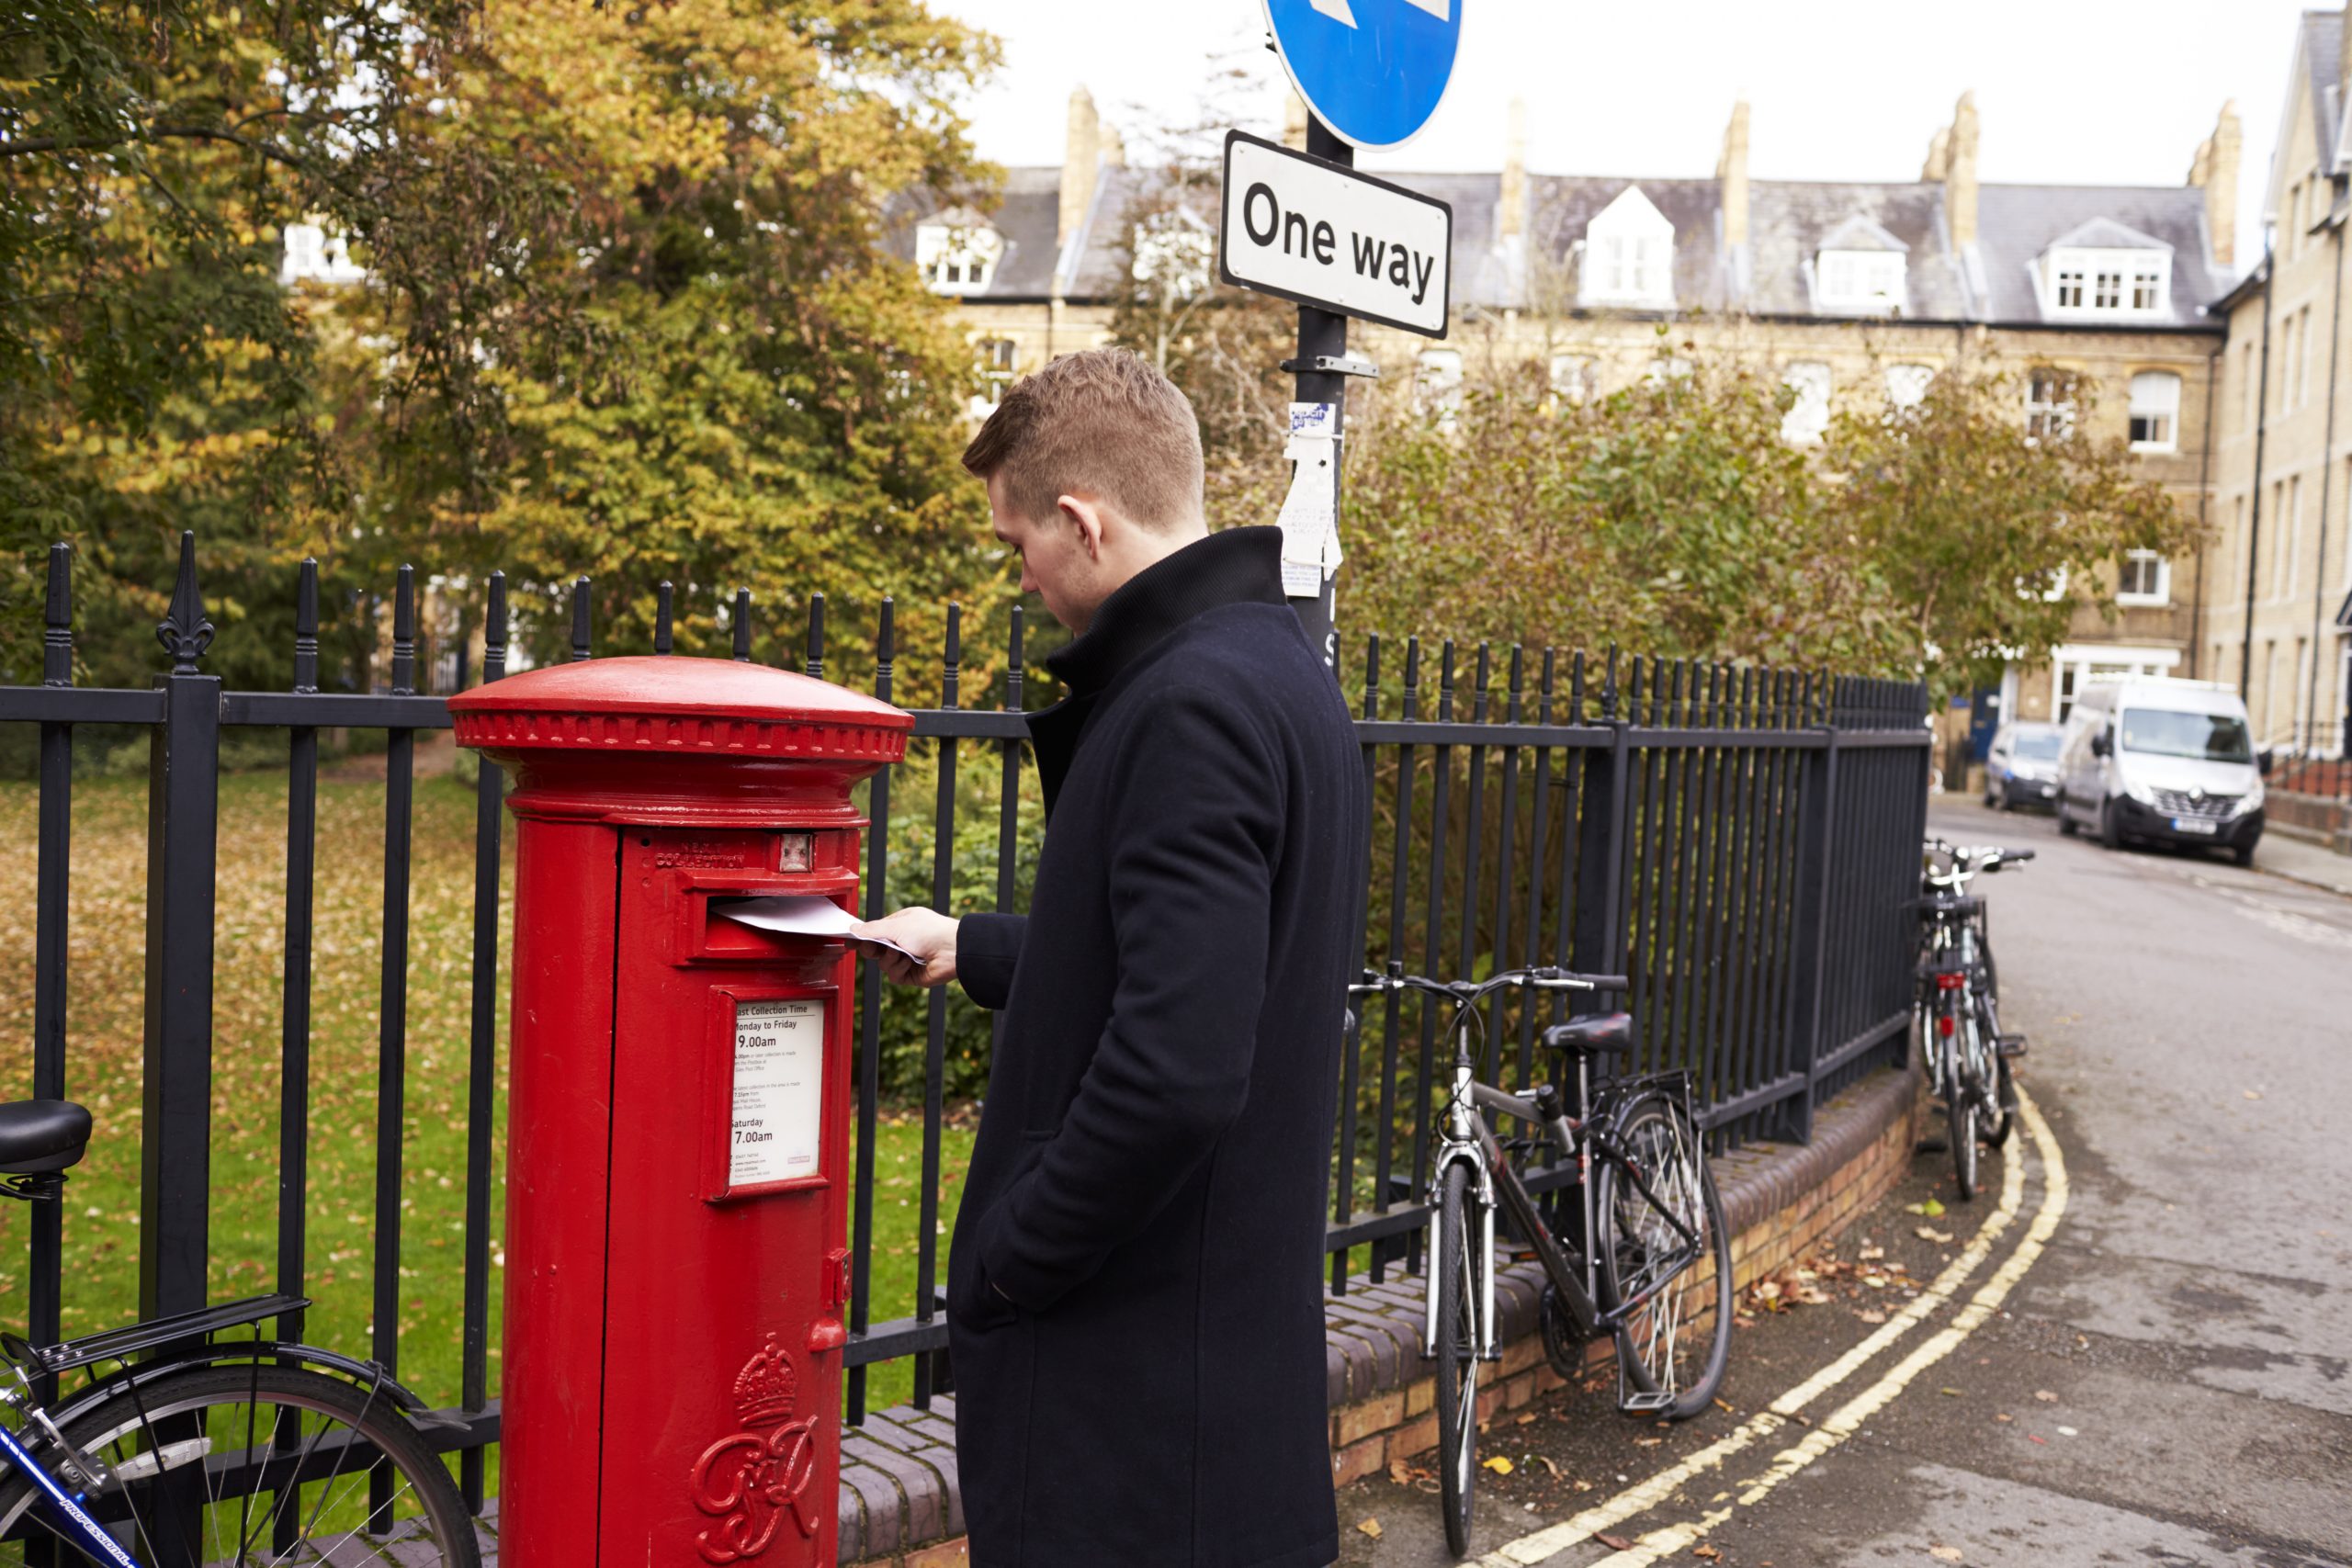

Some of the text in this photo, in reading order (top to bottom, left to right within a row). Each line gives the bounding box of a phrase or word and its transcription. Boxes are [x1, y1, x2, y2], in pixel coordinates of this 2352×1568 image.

[1243, 182, 1434, 305] One way
[653, 852, 745, 869] COLLECTION
[736, 1005, 808, 1017] ast Collection Time
[763, 1021, 772, 1030] to
[774, 1020, 797, 1030] Friday
[738, 1035, 776, 1048] 9.00am
[735, 1131, 773, 1145] 7.00am
[59, 1498, 130, 1567] PROFESSIONAL
